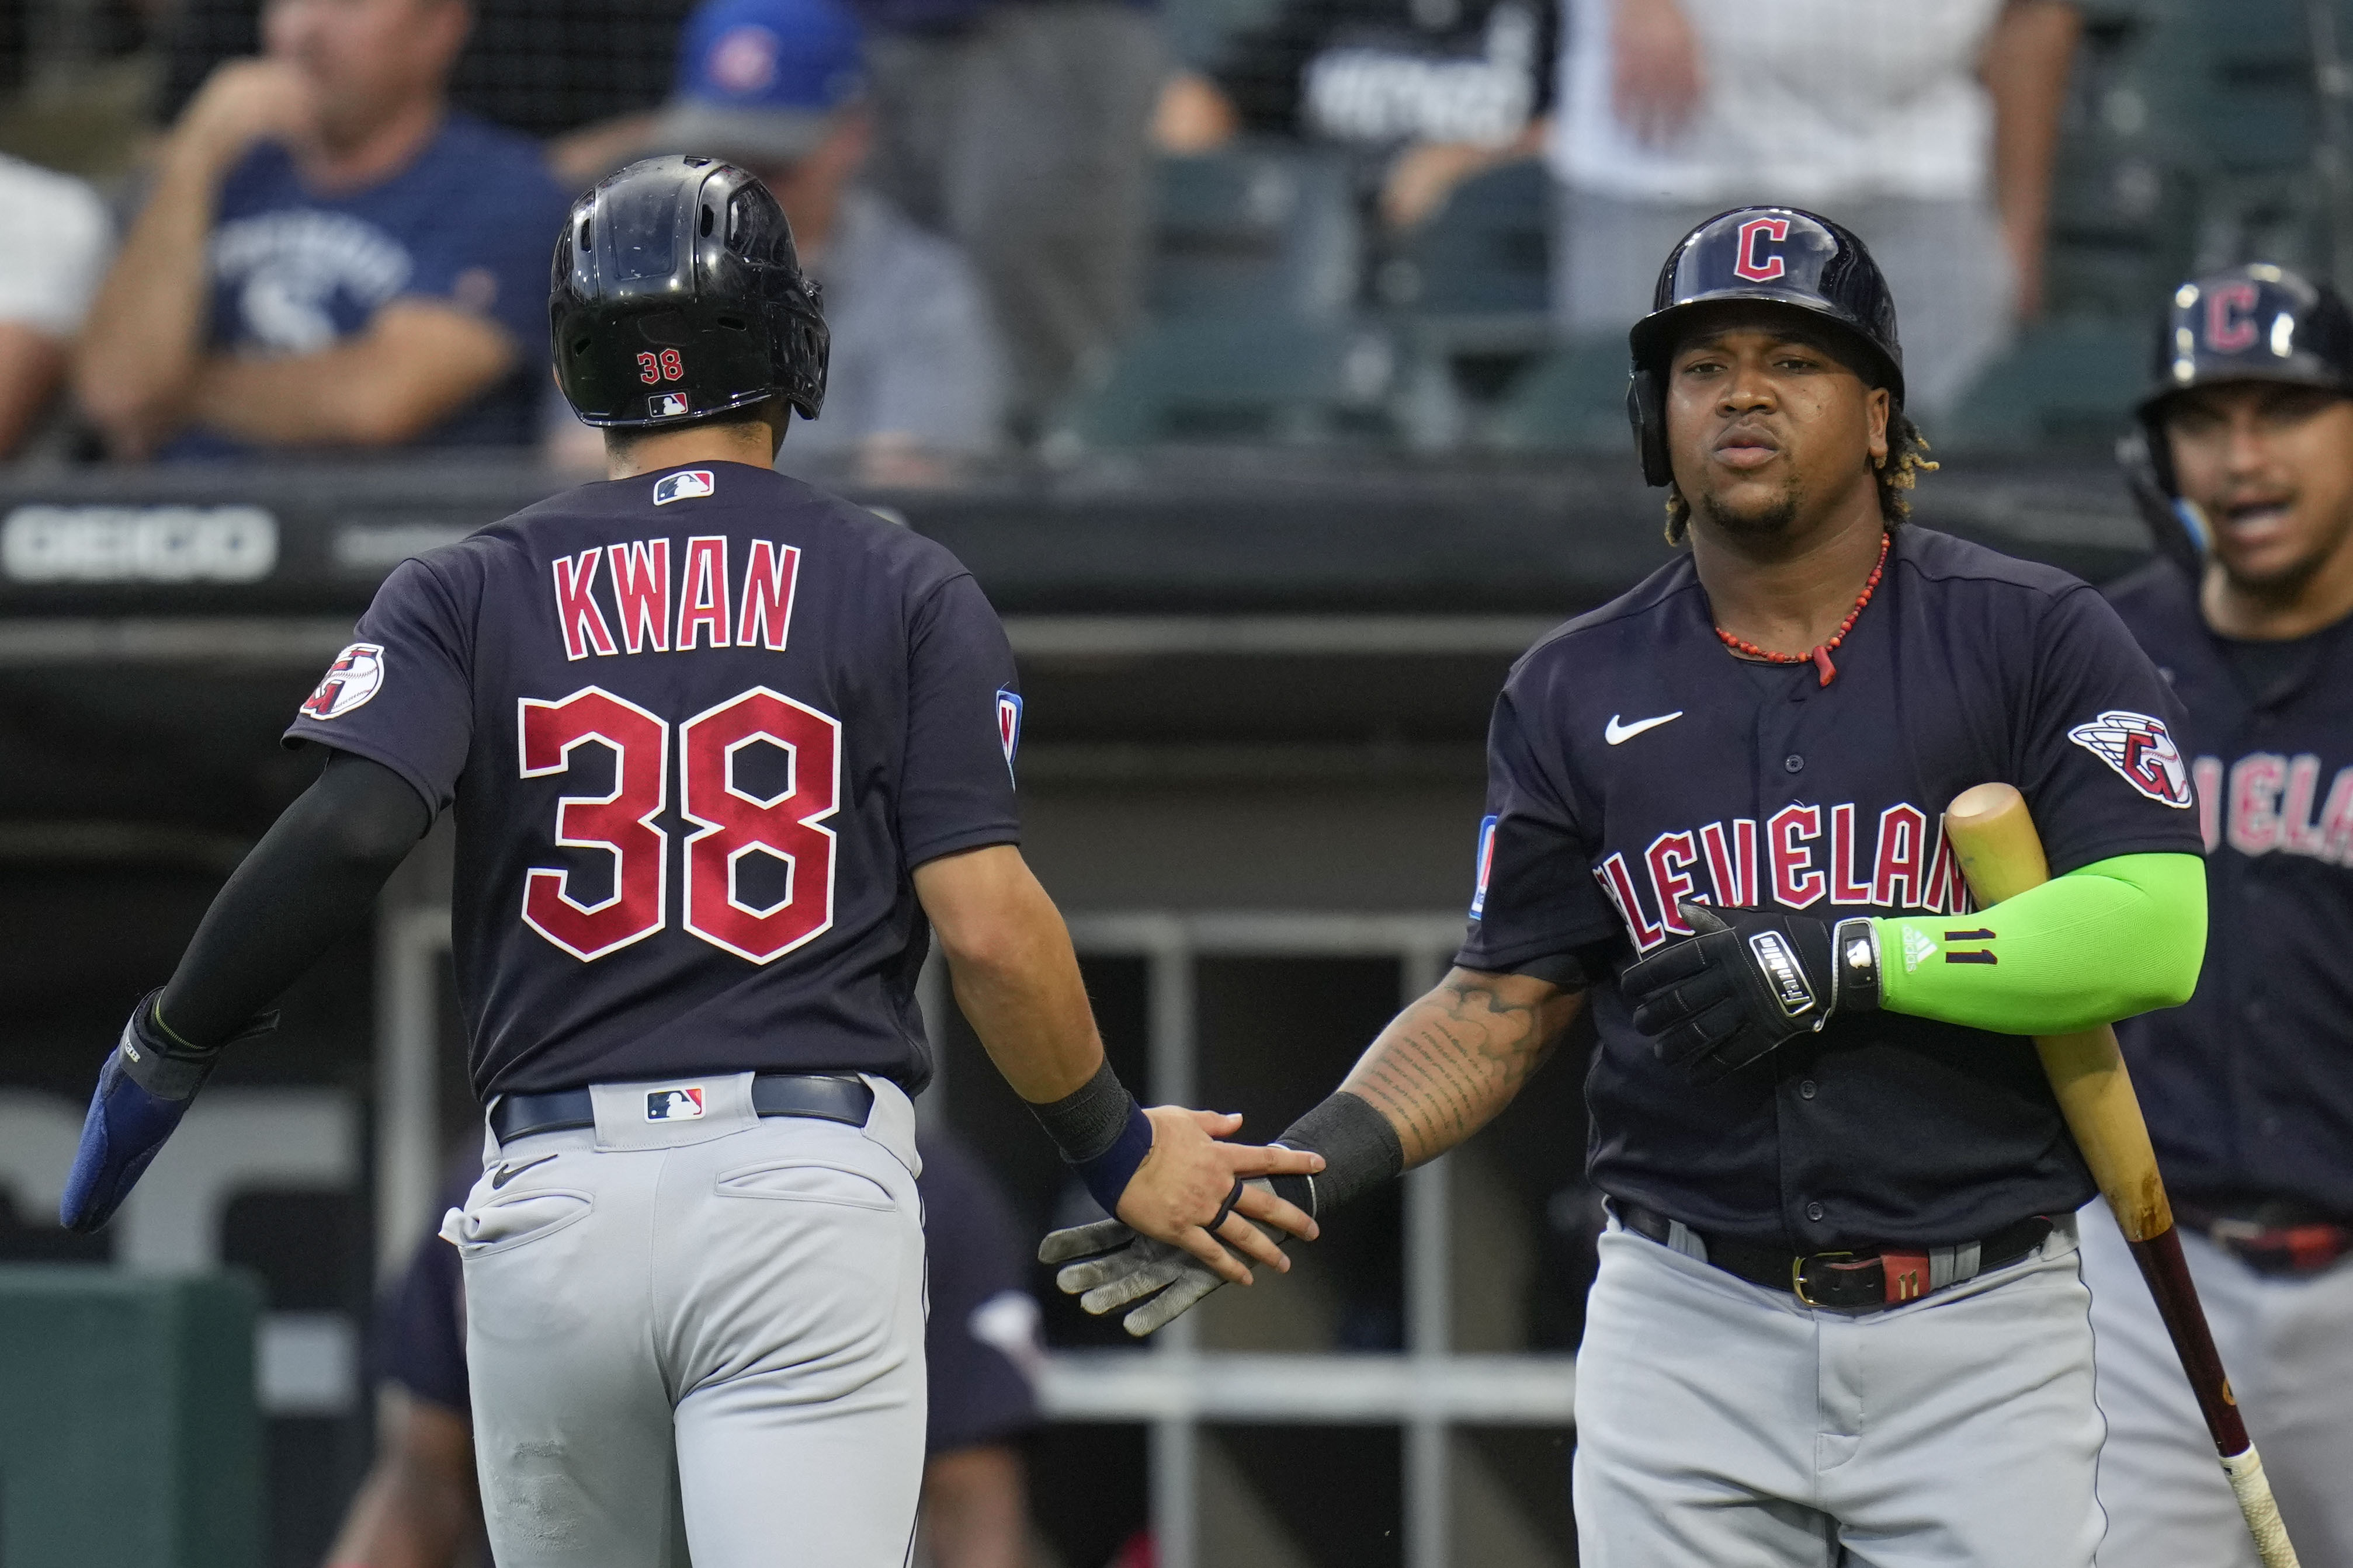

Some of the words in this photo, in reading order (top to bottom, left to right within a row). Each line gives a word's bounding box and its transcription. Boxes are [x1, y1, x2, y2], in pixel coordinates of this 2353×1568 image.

[1734, 217, 1790, 283] C
[2206, 283, 2258, 353] C
[637, 349, 683, 384] 38
[552, 535, 801, 661] KWAN
[518, 685, 842, 966] 38
[1592, 802, 1972, 954] LEVELAN
[1759, 937, 1810, 1006] Franklin
[1903, 924, 1917, 973] adidas
[1944, 929, 1998, 965] 11
[1898, 1269, 1918, 1300] 11
